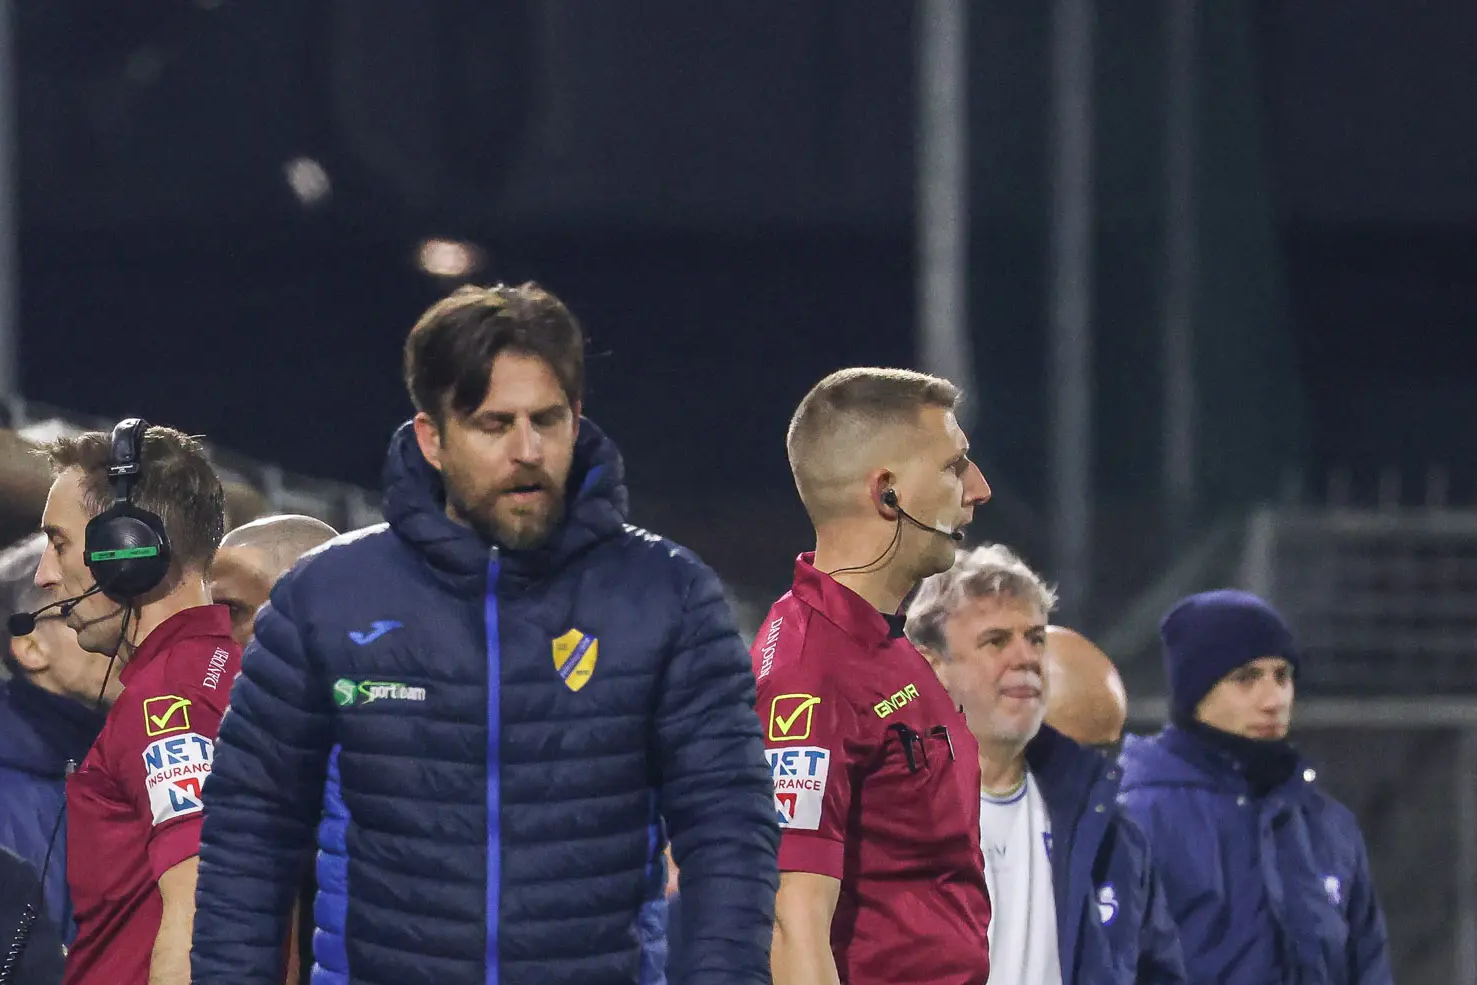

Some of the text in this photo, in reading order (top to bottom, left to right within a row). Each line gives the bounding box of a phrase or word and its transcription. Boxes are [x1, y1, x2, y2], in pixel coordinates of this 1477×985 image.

[874, 683, 920, 719] GIVOVA
[145, 736, 210, 774] NET
[148, 762, 212, 789] INSURANC
